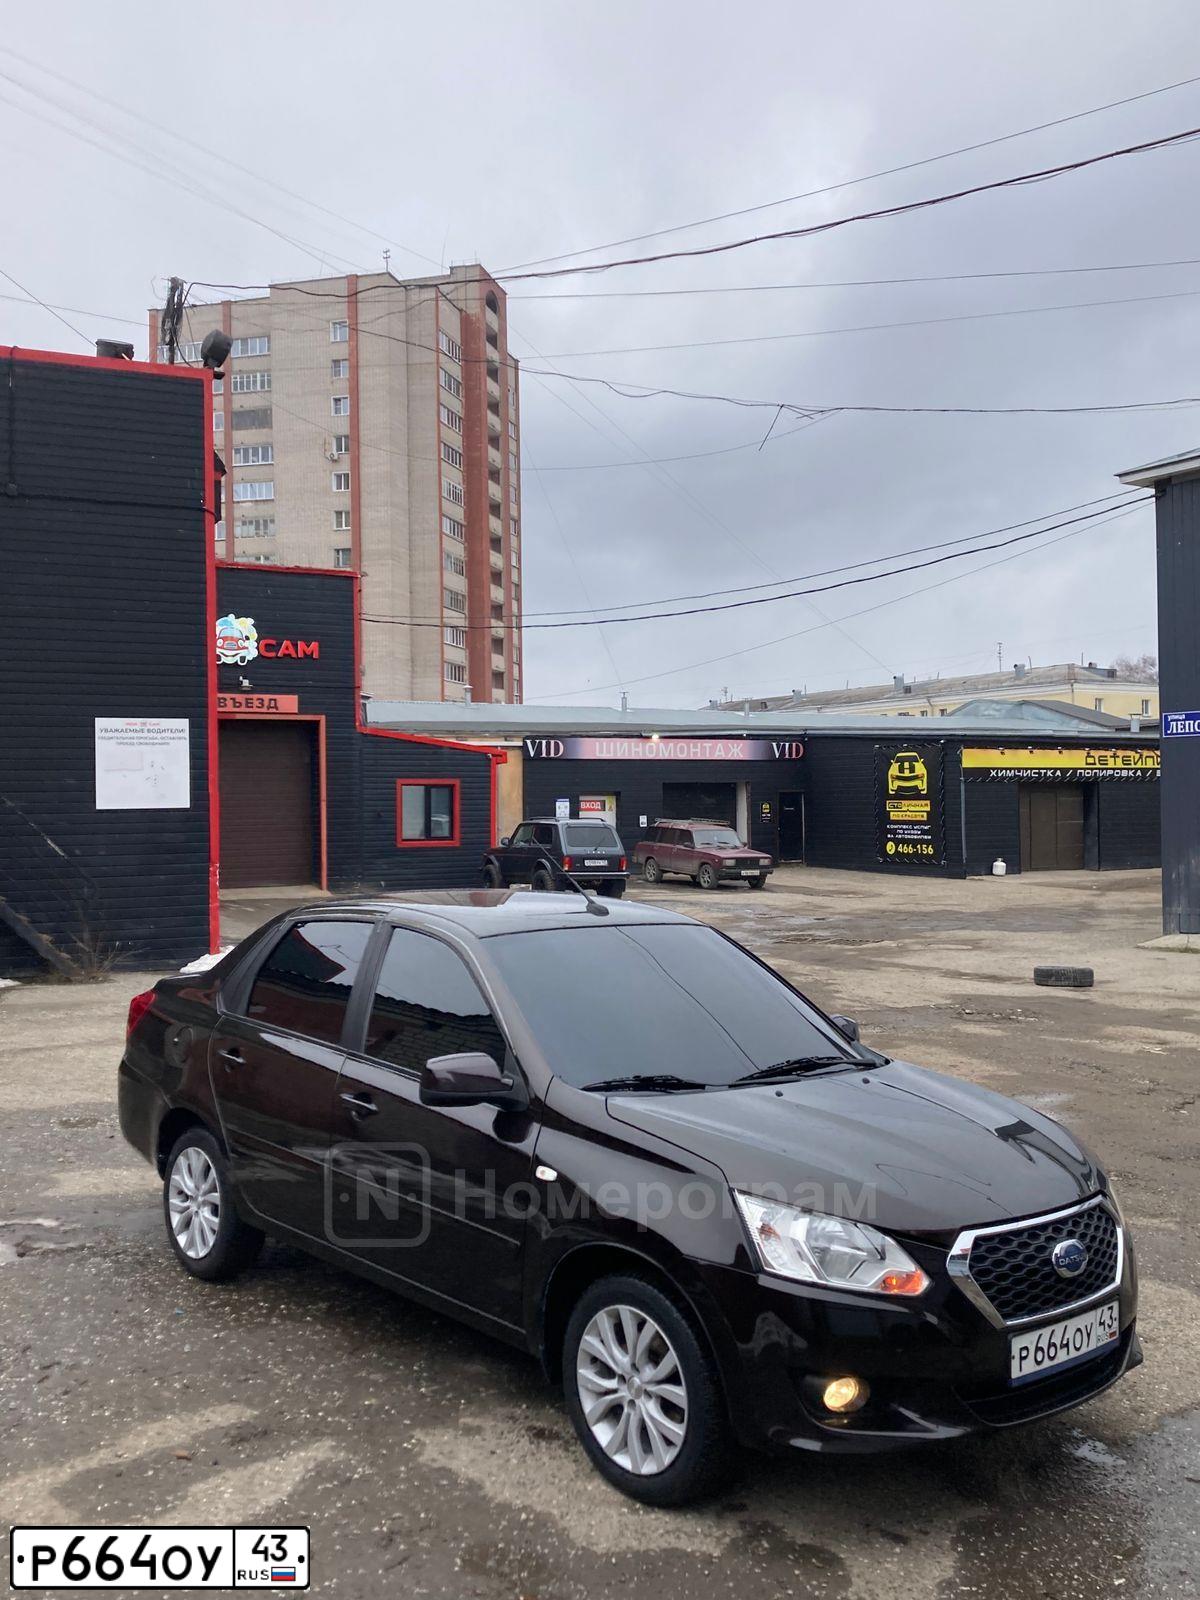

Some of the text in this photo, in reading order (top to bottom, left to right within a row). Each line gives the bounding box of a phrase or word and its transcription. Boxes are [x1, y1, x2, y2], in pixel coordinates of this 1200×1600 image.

[258, 639, 320, 659] САМ
[217, 697, 279, 711] ВЪЕЗД
[525, 739, 564, 758] VID
[595, 742, 744, 759] ШИНОМОНТАЖ
[772, 742, 804, 759] VID
[989, 769, 1062, 777] ХИМЧИСТКА
[1076, 769, 1142, 777] ПОЛИРОВКА
[580, 801, 601, 810] ВХОД
[898, 844, 934, 854] 466-156
